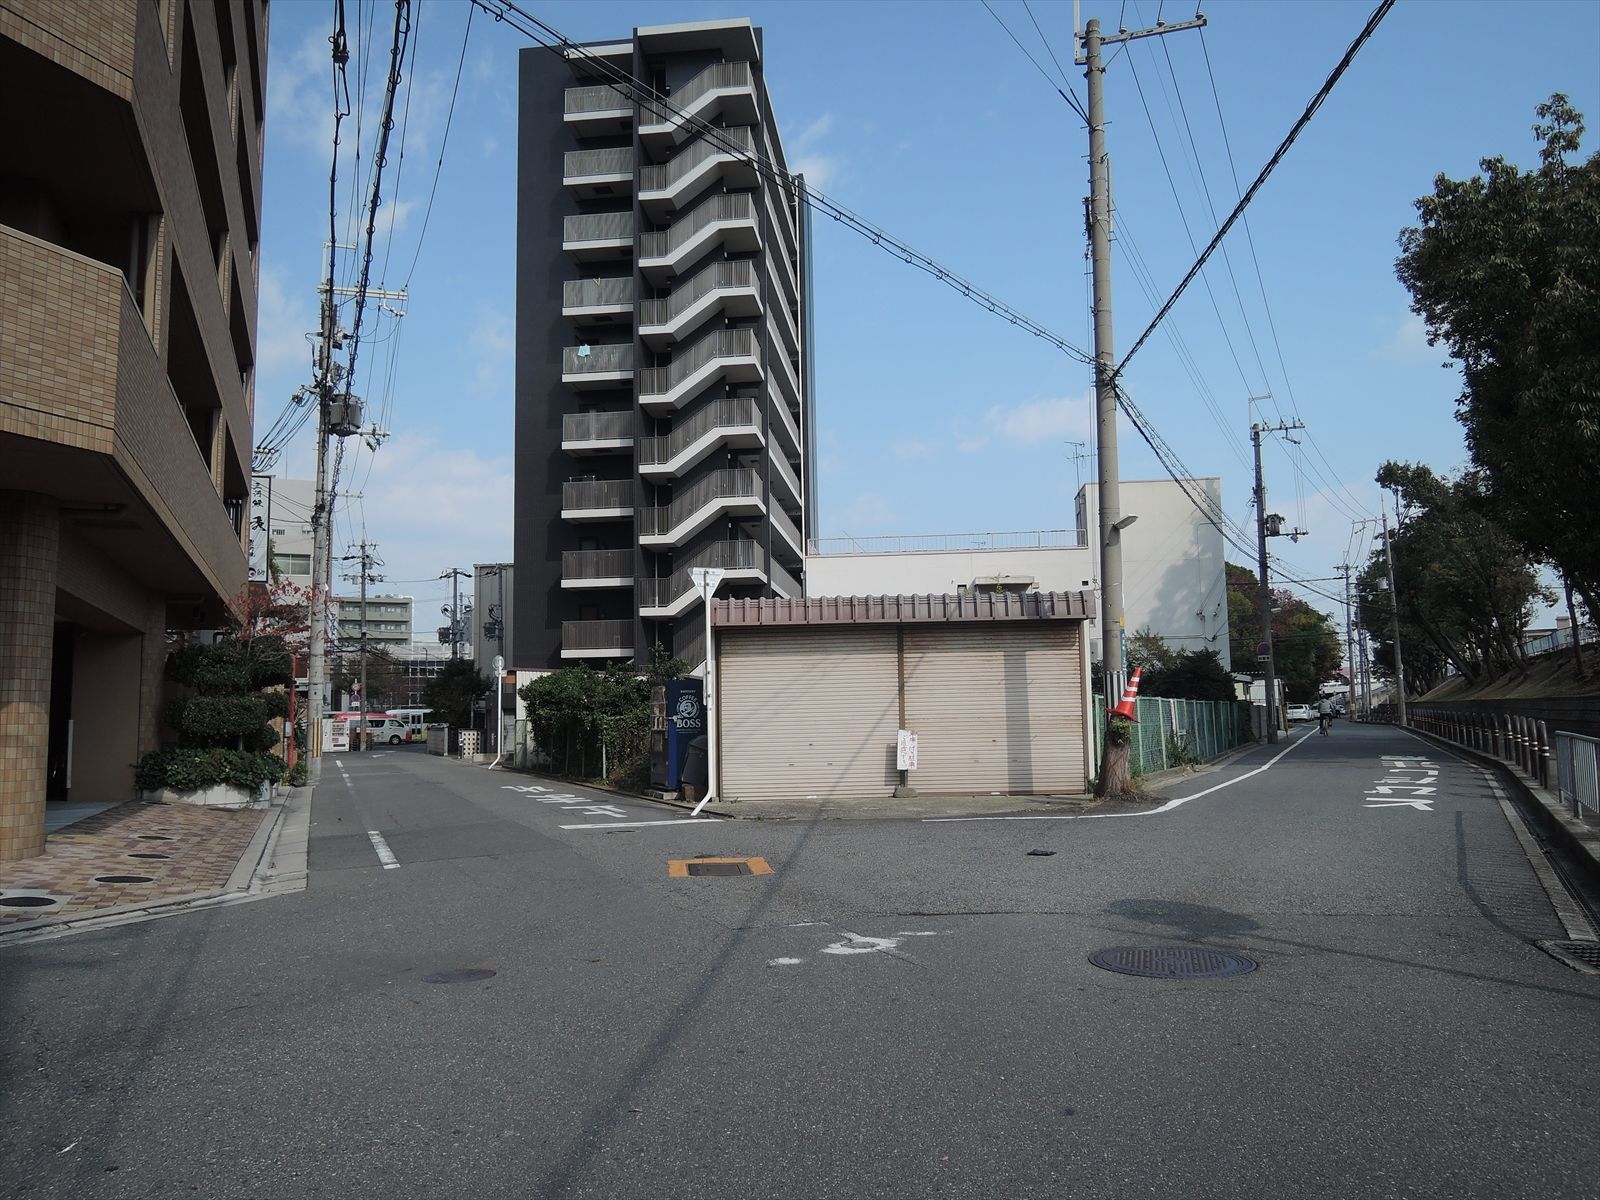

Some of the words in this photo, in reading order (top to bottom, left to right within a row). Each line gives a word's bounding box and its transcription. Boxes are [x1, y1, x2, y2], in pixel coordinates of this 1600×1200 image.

[676, 718, 701, 728] BOSS
[500, 785, 628, 818] 止まれ
